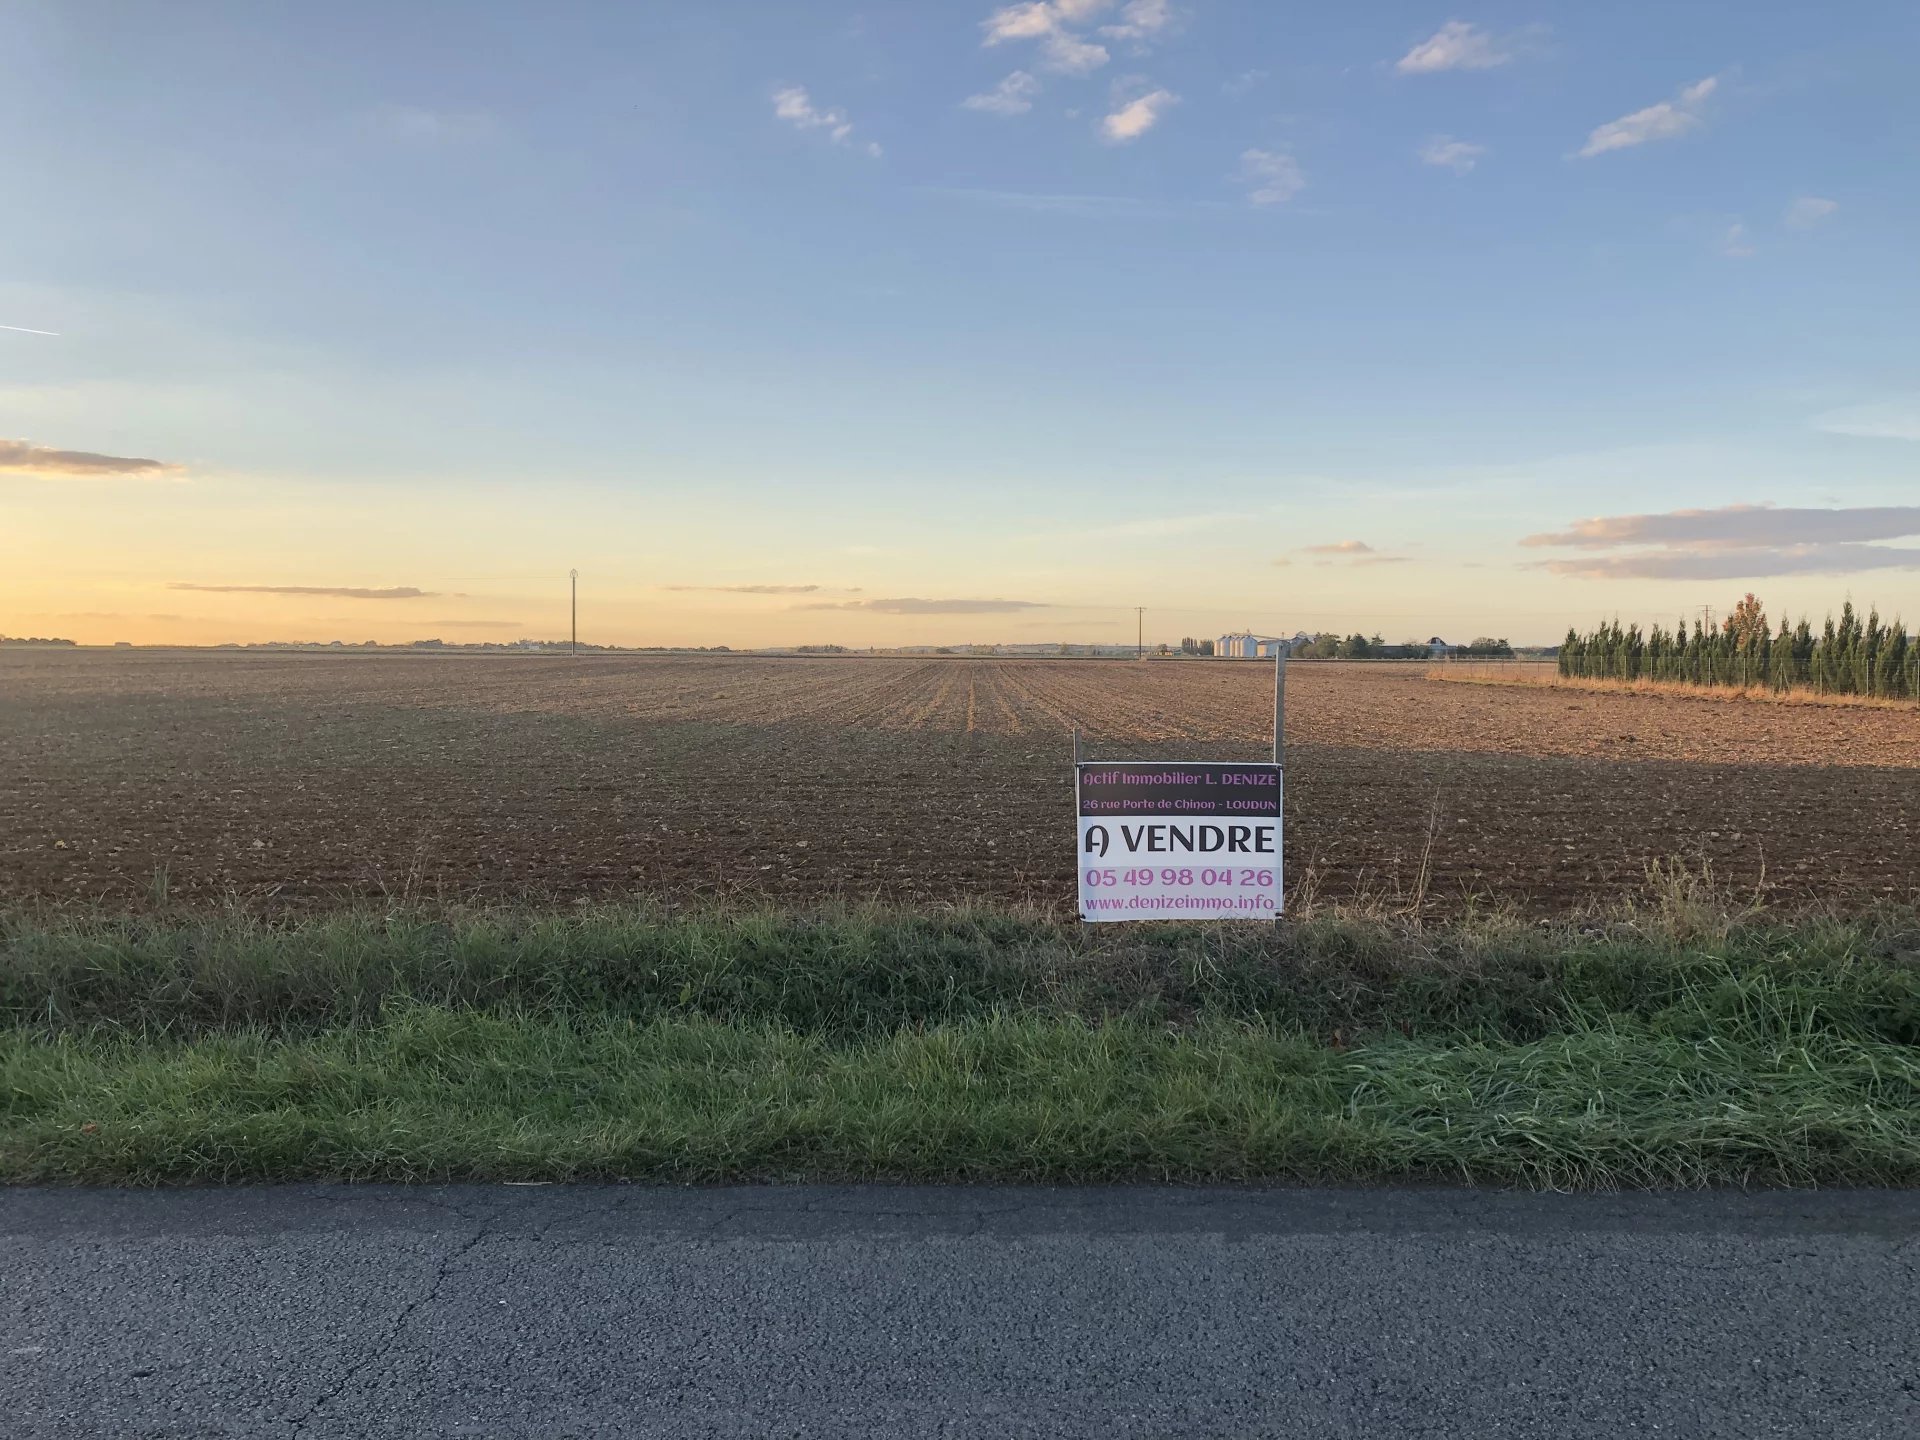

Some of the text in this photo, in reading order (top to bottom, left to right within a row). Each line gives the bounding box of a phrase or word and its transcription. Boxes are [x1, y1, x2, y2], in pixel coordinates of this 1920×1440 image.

[1083, 771, 1277, 786] Actif Immobilier L. DENIZE
[1083, 799, 1099, 809] 26
[1101, 801, 1120, 809] rue
[1123, 799, 1155, 809] Porte
[1157, 799, 1172, 809] de
[1174, 799, 1216, 810] Chinon
[1226, 800, 1277, 810] LOUDUN
[1085, 825, 1275, 858] A VENDRE
[1086, 868, 1273, 887] 05 49 98 04 26
[1085, 894, 1275, 911] www.denizeimmo.info
